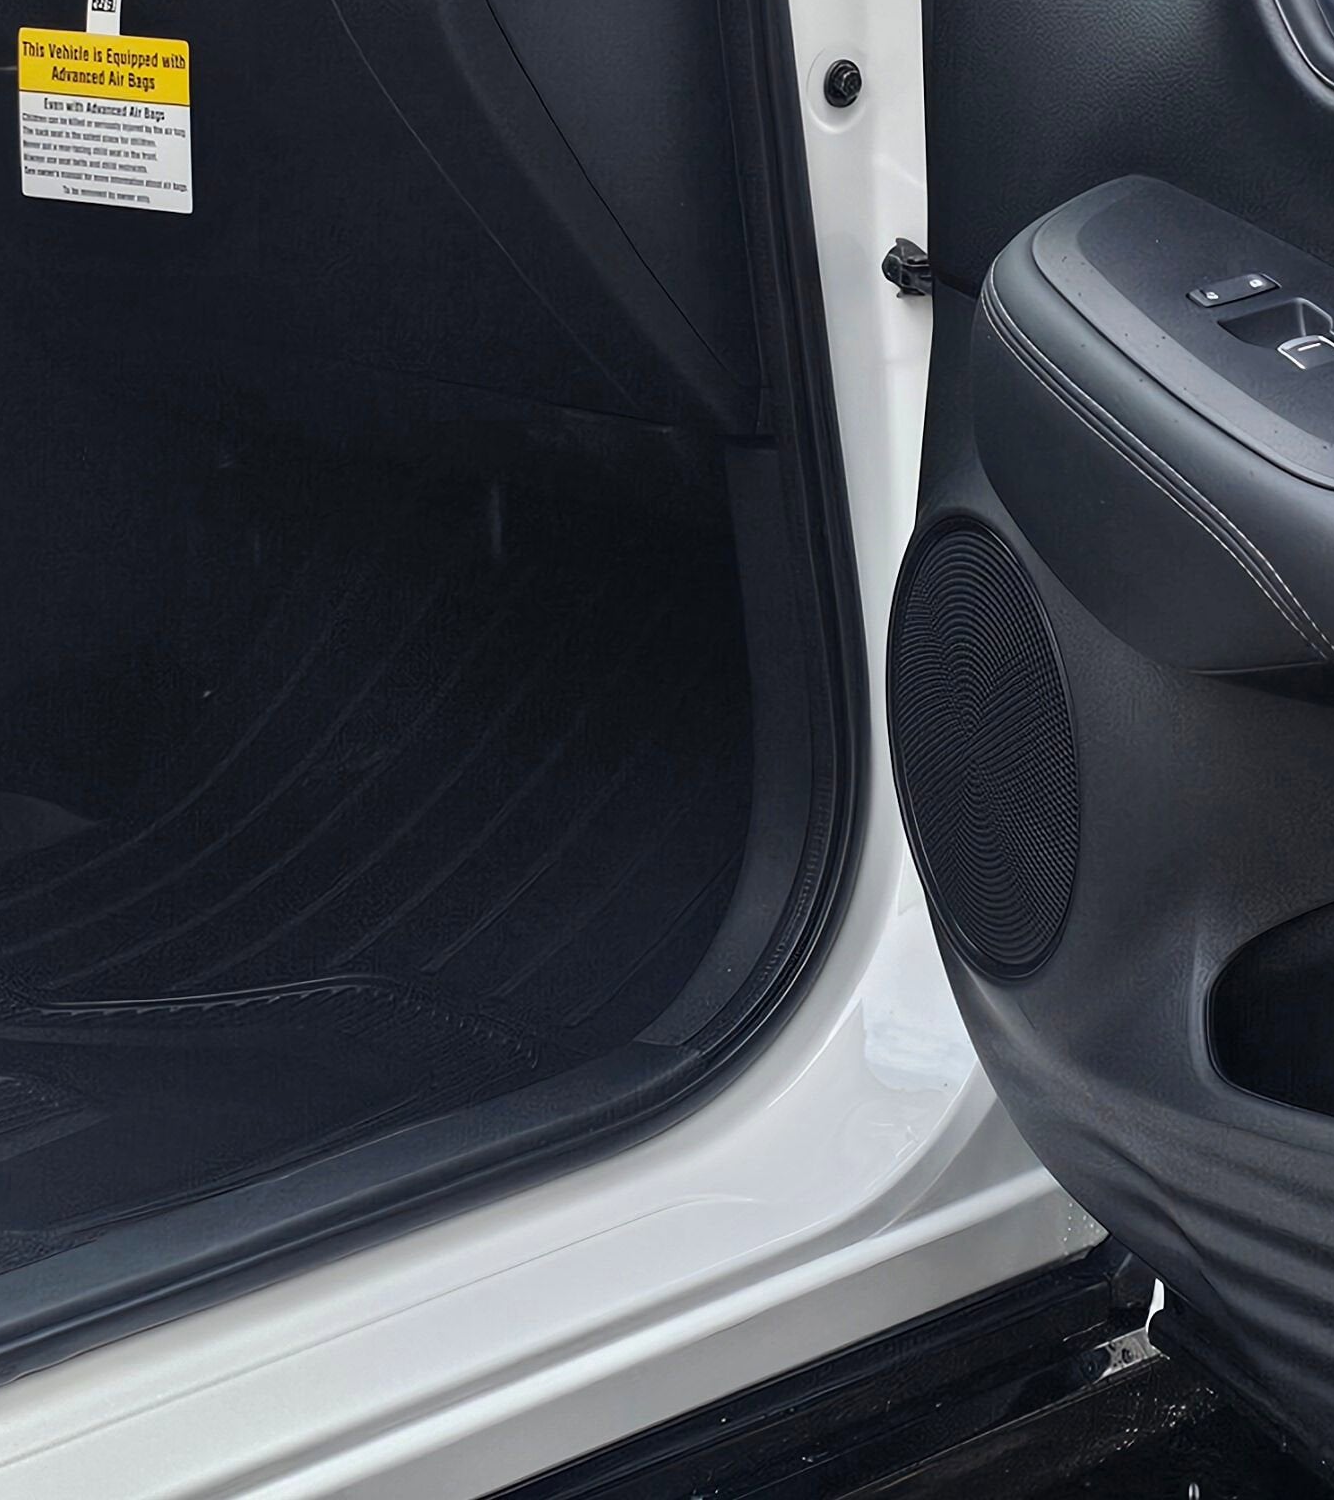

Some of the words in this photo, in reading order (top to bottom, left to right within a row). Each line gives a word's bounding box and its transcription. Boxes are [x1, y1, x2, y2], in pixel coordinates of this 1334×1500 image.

[22, 41, 44, 57] This
[48, 43, 89, 61] Vehicle
[106, 48, 158, 69] Equipped
[162, 53, 186, 69] with
[51, 66, 105, 85] Advanced
[108, 70, 124, 86] Air
[128, 72, 155, 92] Bags
[87, 102, 127, 117] Advanced
[129, 106, 141, 118] Air
[144, 107, 165, 122] Bags
